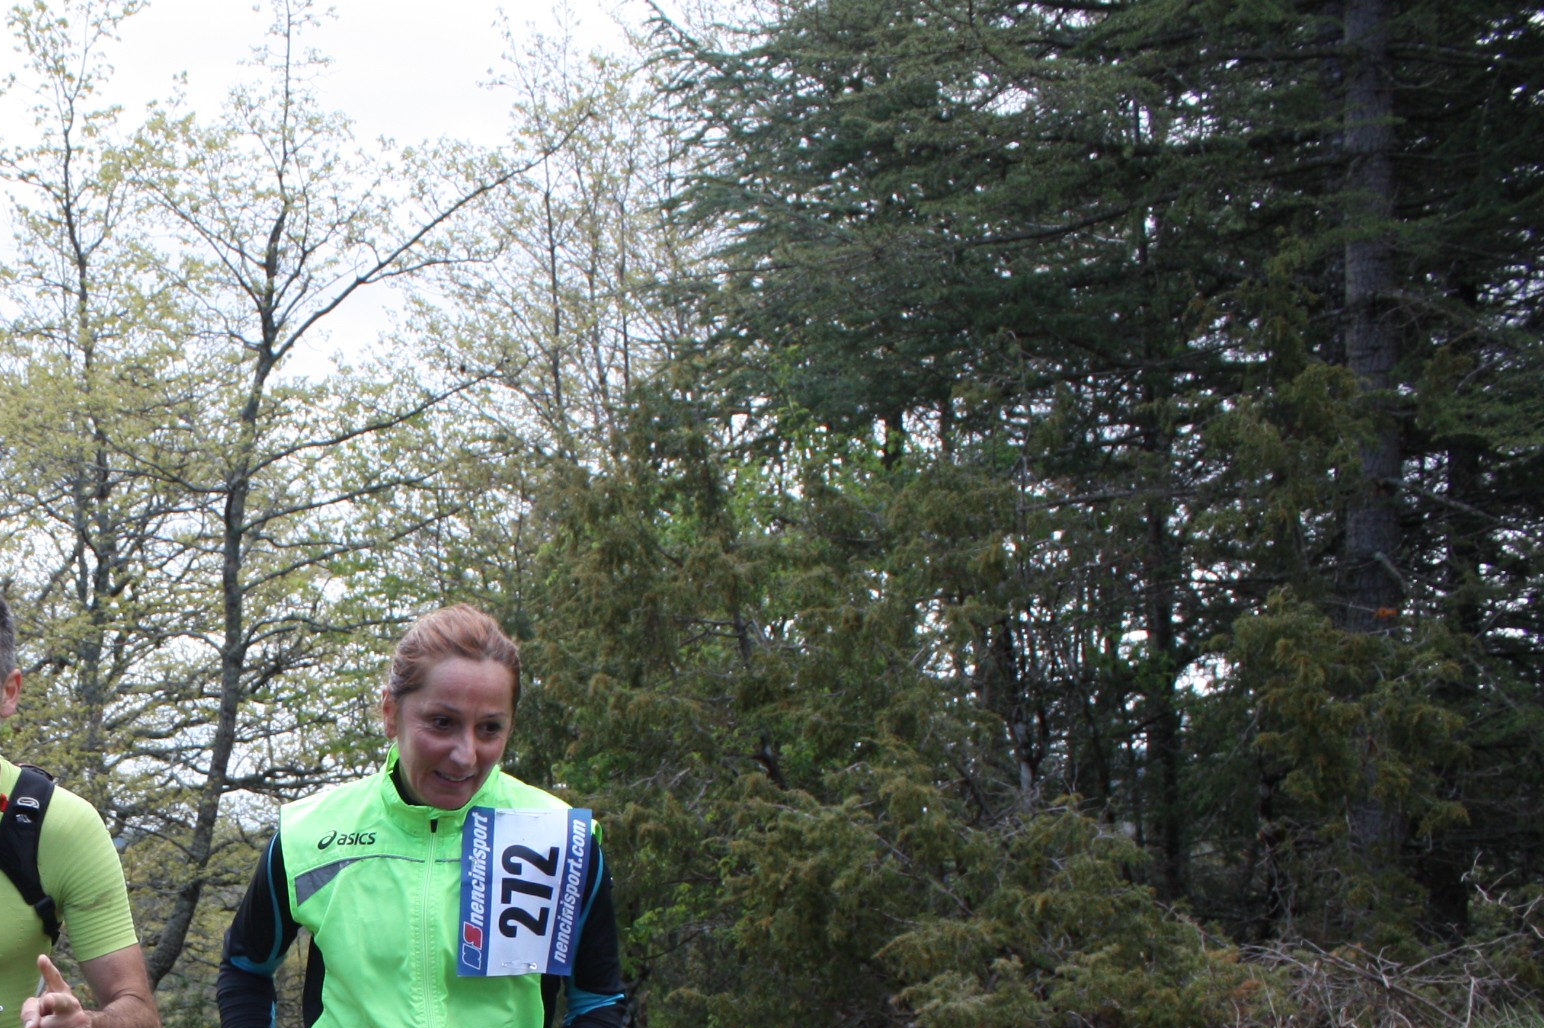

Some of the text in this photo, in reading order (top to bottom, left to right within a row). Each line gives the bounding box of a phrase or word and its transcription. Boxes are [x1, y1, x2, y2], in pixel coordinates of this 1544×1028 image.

[337, 832, 377, 846] asics
[468, 811, 490, 927] nencinisport
[498, 844, 560, 938] 272
[554, 819, 587, 964] nencinisport.com
